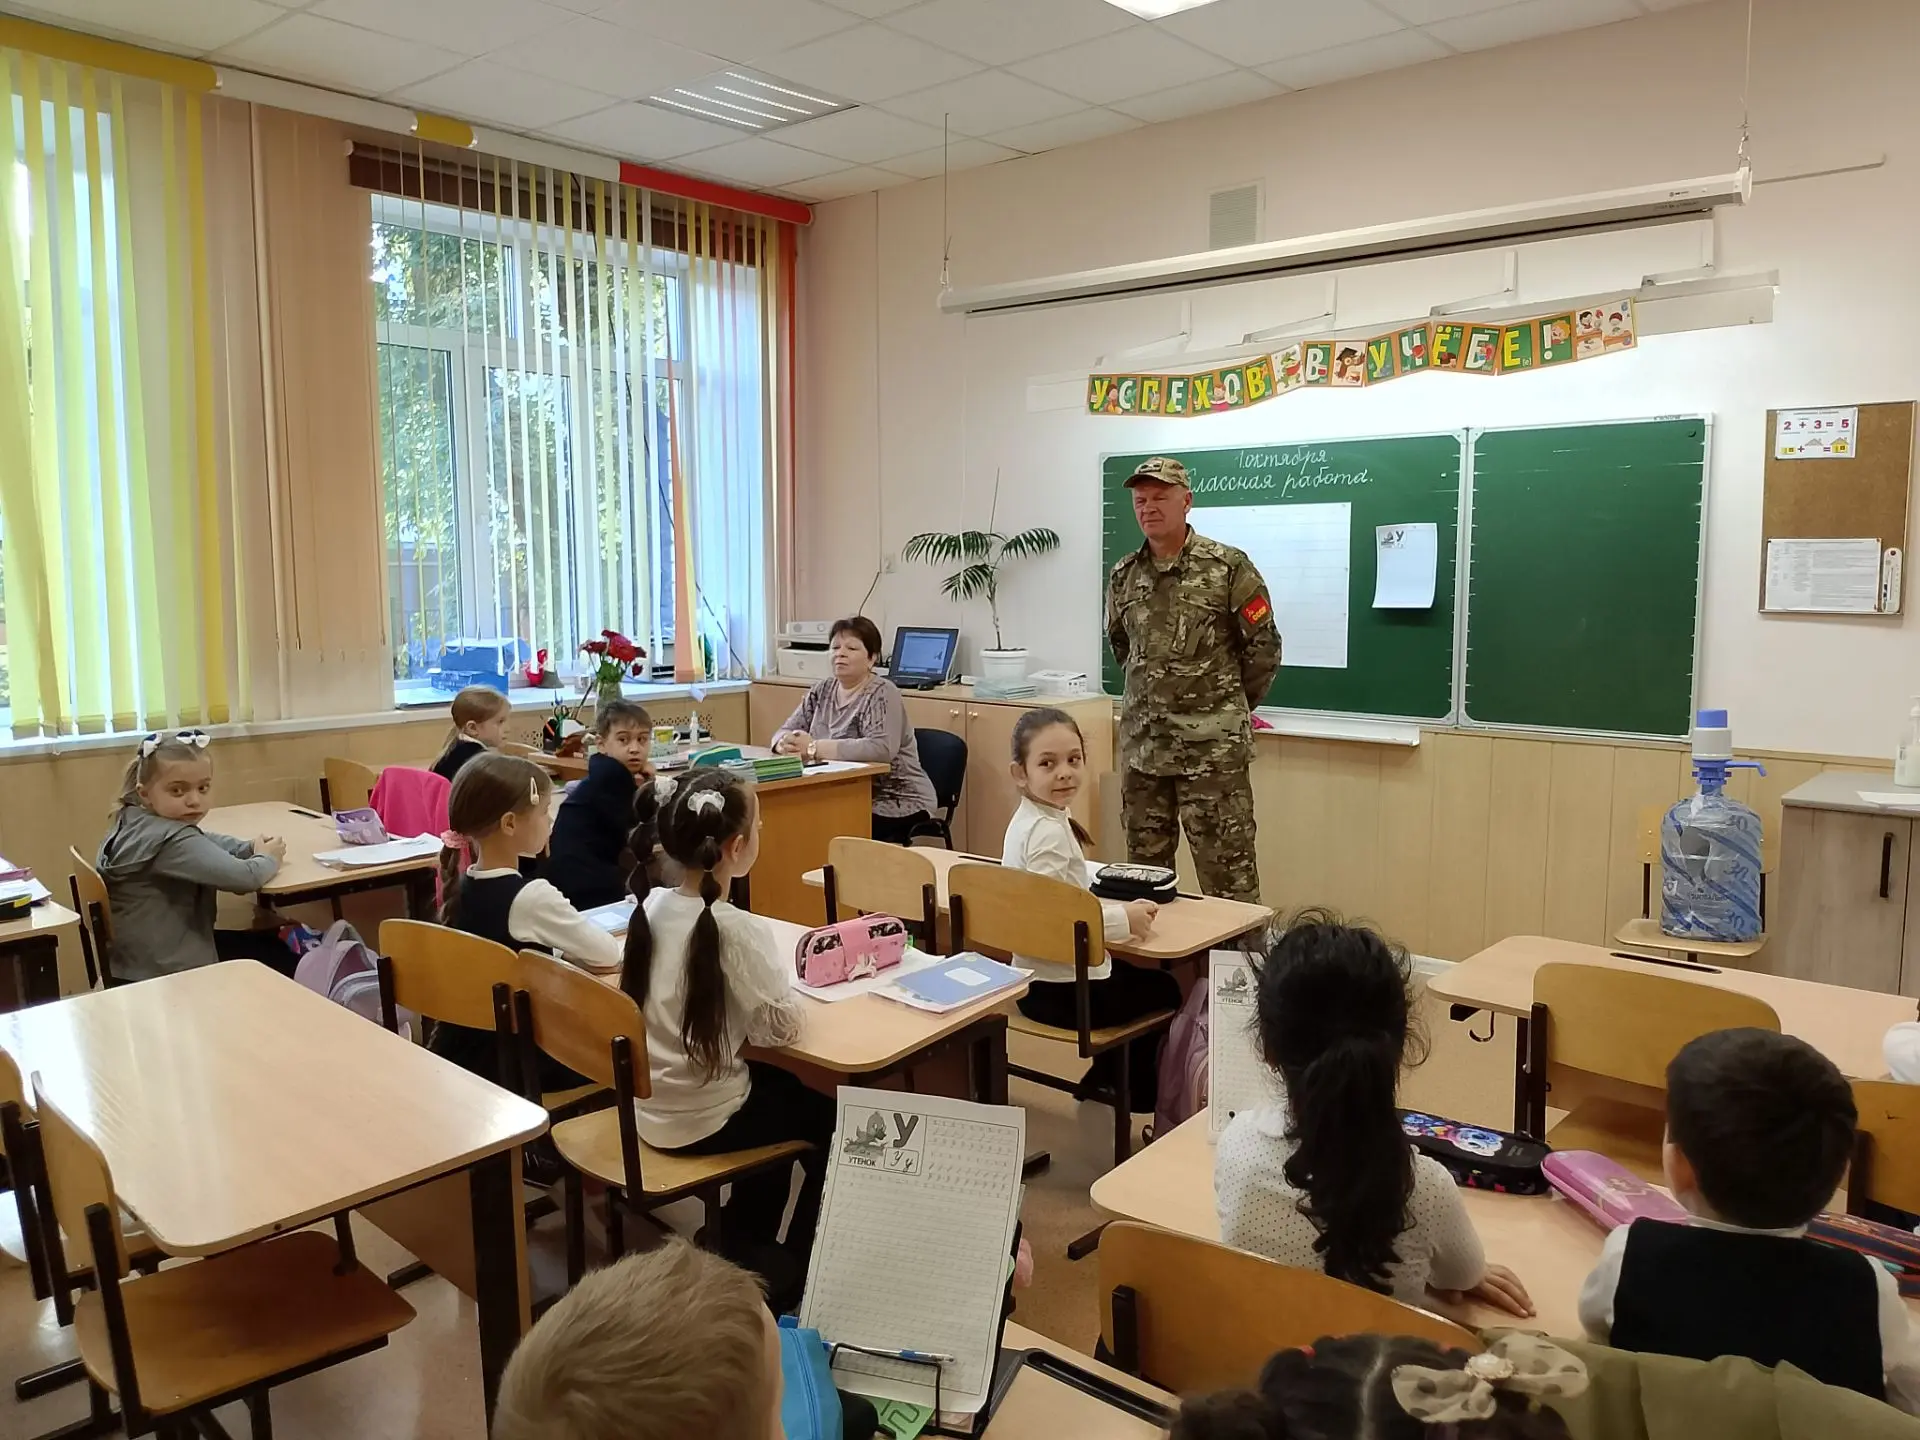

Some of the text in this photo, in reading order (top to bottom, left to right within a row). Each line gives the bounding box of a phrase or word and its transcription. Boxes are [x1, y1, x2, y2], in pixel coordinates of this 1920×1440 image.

[1092, 366, 1267, 412] УСПЕХОВ
[1306, 348, 1324, 383] В
[1783, 421, 1792, 430] 2
[1814, 420, 1822, 430] 3
[1841, 419, 1849, 428] 5
[893, 1112, 919, 1148] У
[848, 1156, 877, 1168] УТЕНОК
